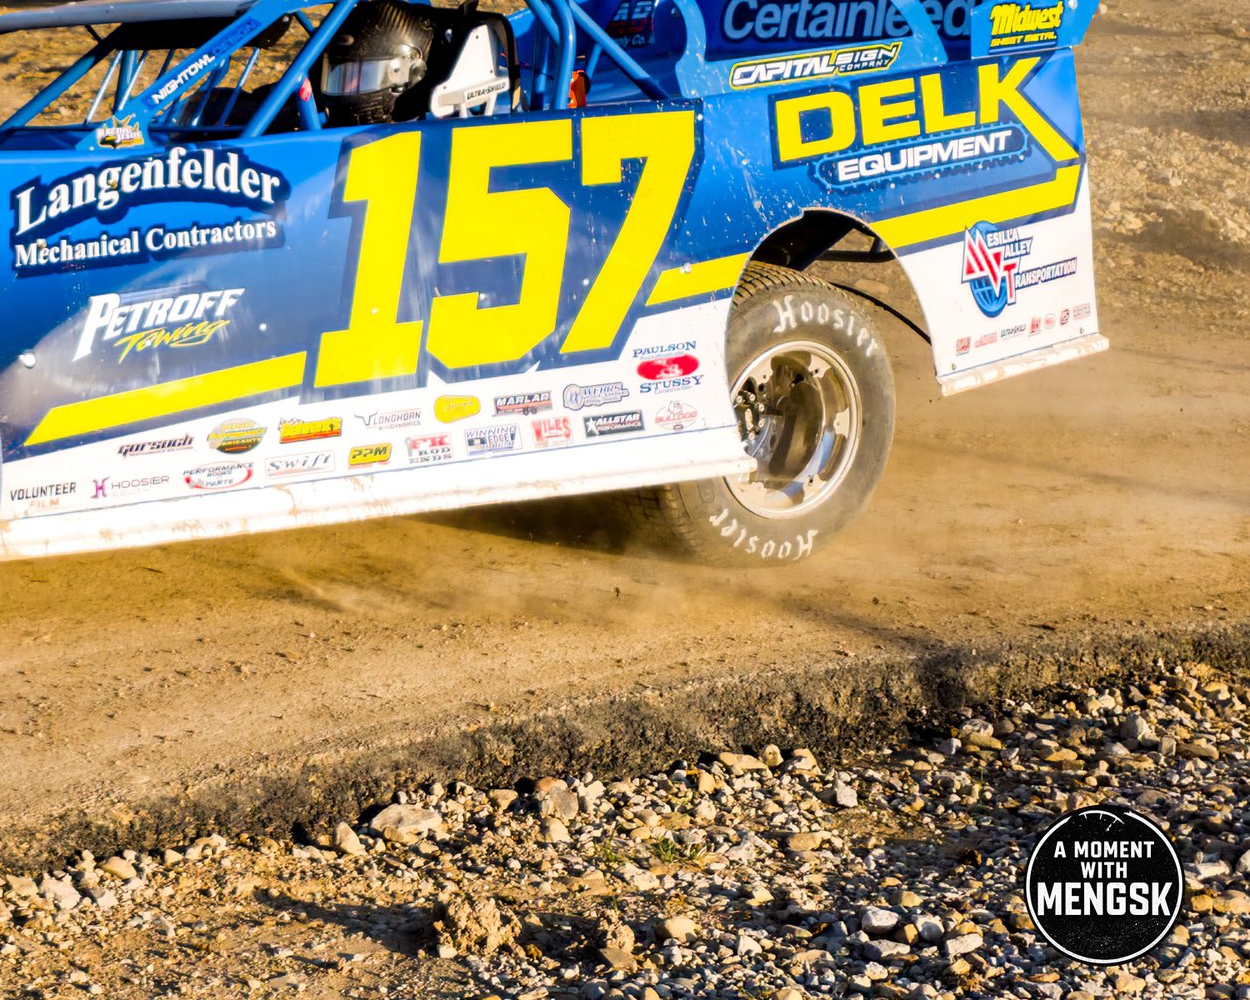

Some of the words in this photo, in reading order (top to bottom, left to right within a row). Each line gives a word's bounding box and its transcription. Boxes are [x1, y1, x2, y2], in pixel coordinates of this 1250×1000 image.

[990, 0, 1065, 35] Midwest
[732, 55, 836, 85] CAPITAL
[835, 47, 898, 64] SIGN
[839, 59, 891, 72] COMPANY
[776, 57, 1080, 162] DELK
[837, 130, 1012, 182] EQUIPMENT
[15, 146, 281, 236] Langenfelder
[14, 231, 140, 267] Mechanical
[145, 220, 277, 250] Contractors
[314, 110, 694, 388] 157
[72, 287, 246, 362] PETROFF
[113, 319, 231, 365] Towing
[632, 340, 697, 358] PAULSON
[639, 374, 704, 394] STUSSY
[373, 411, 421, 425] LONGHORN
[466, 425, 518, 439] WINNING
[596, 413, 641, 426] ALLSTAR
[10, 482, 77, 501] VOLUNTEER
[111, 475, 170, 490] HOOSIER
